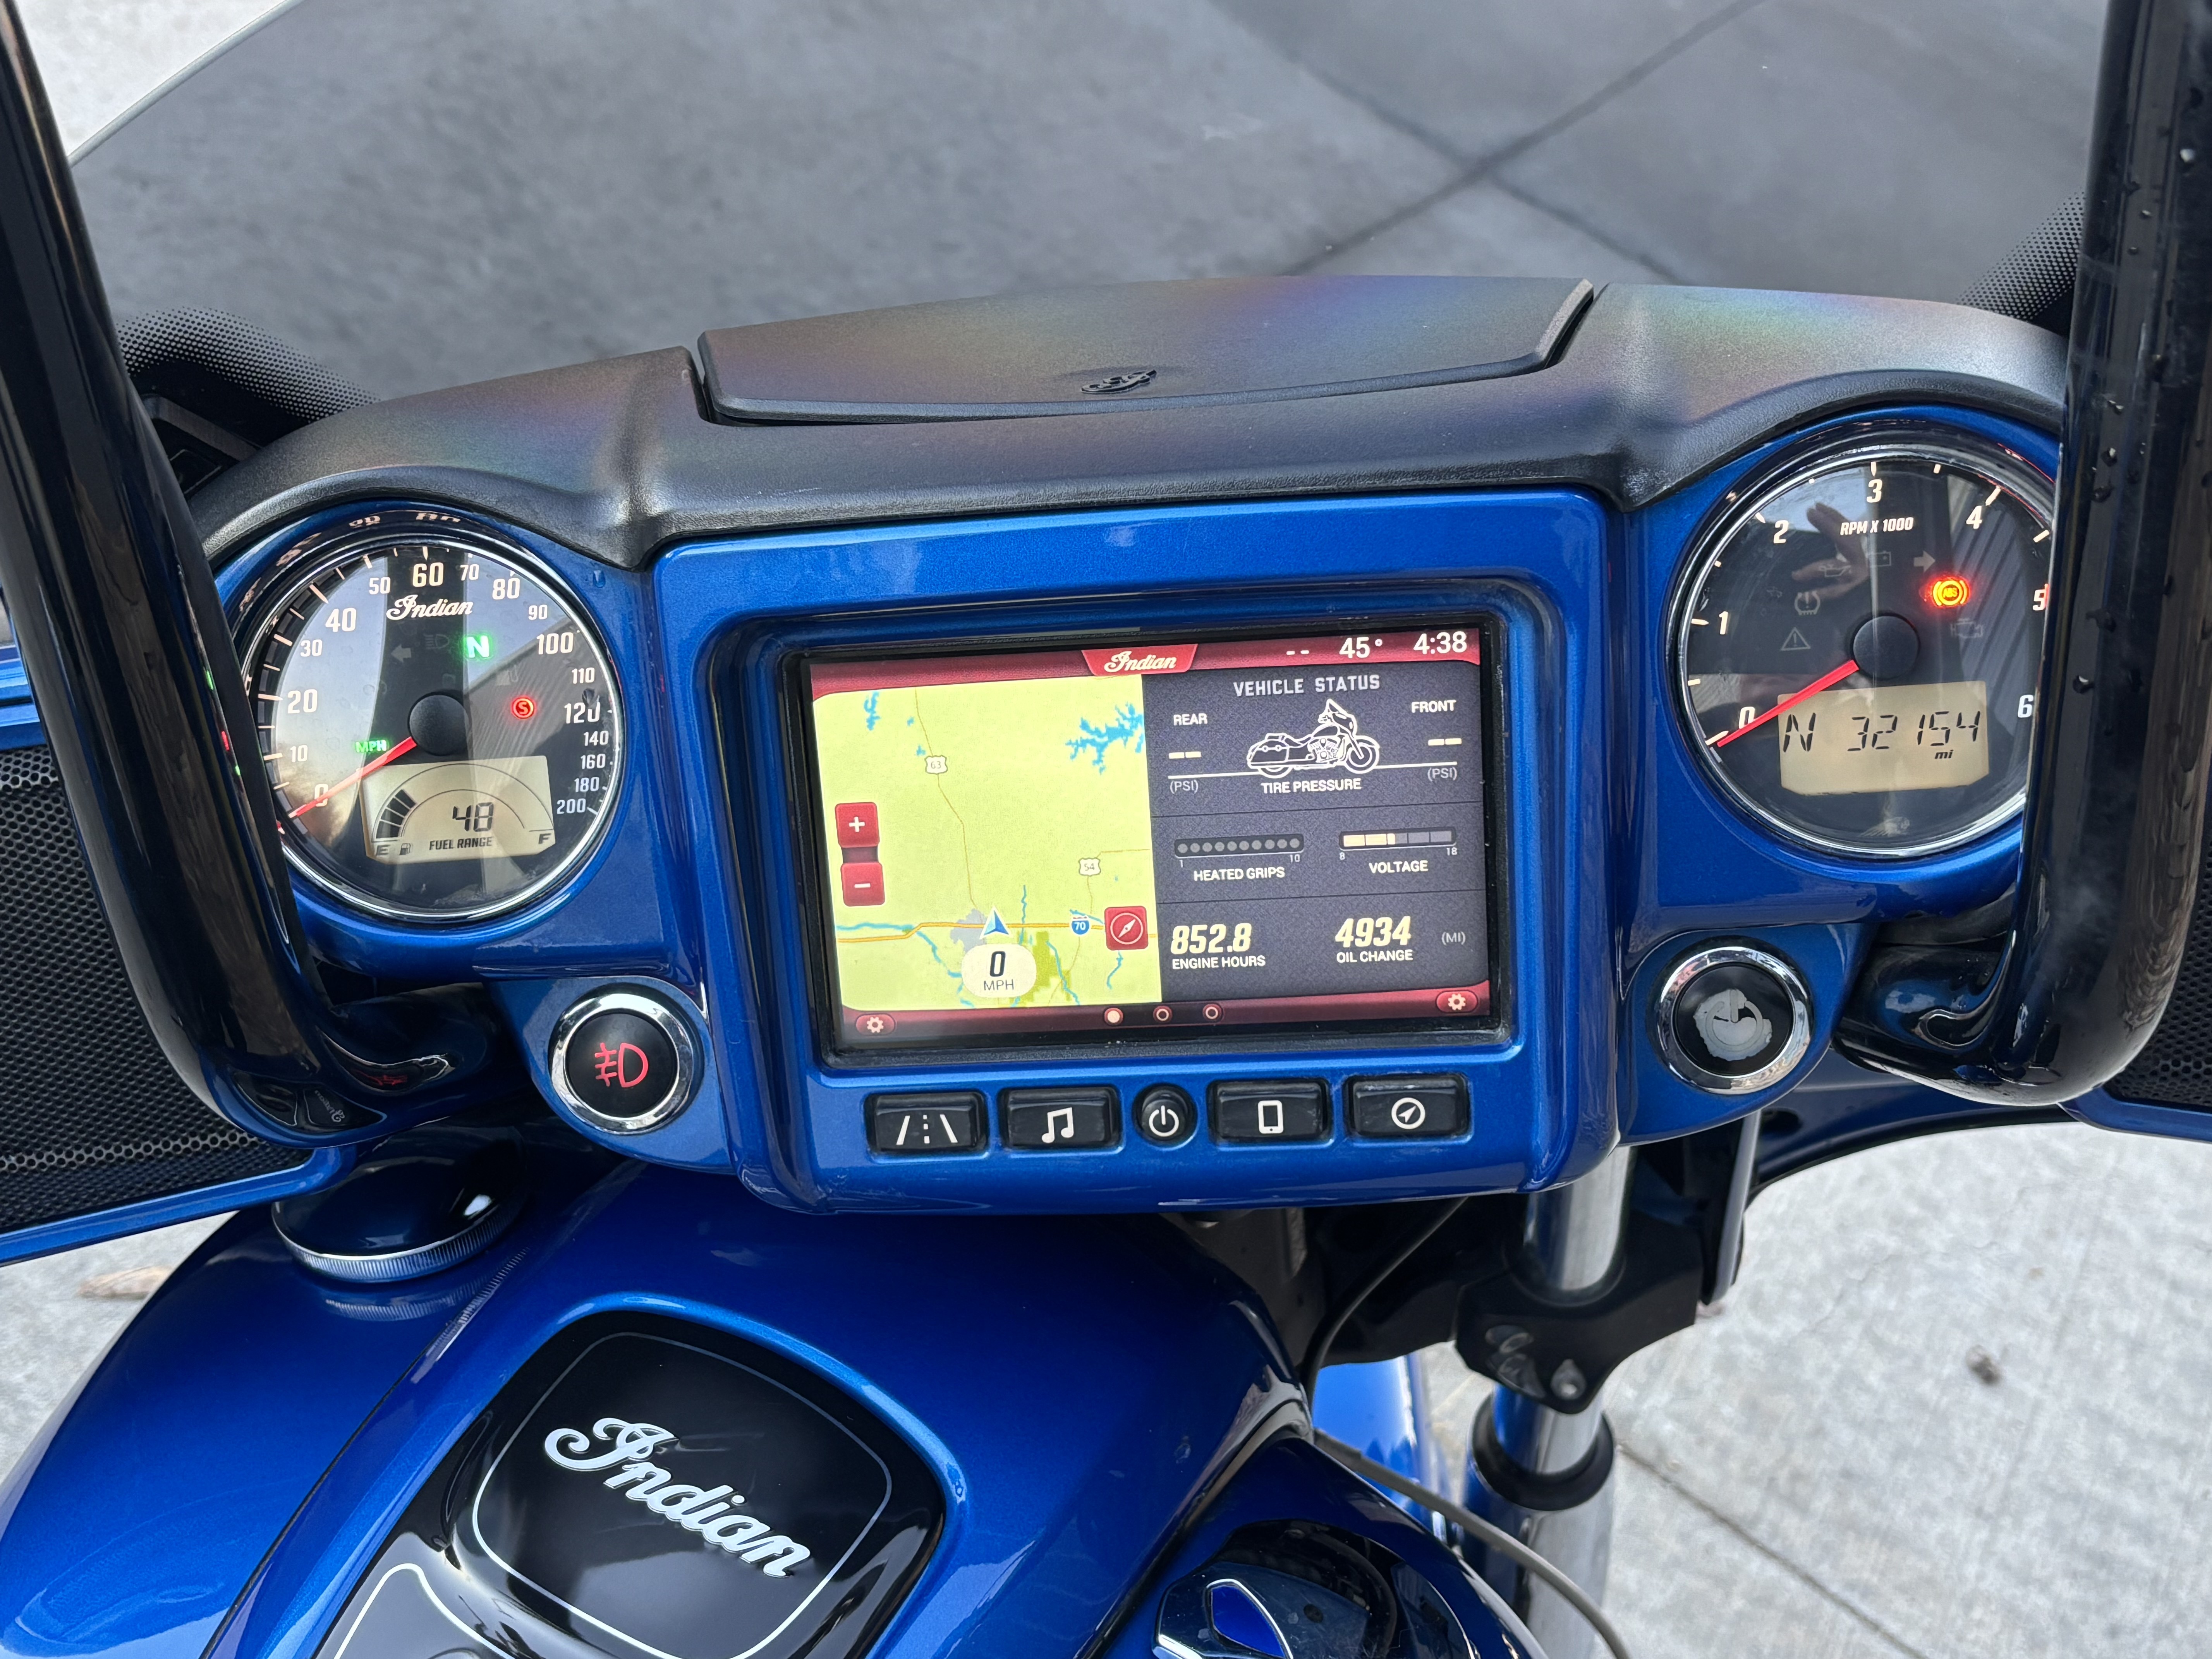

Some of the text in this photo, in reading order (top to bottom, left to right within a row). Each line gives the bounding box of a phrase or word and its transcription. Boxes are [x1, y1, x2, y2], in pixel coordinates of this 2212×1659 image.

[1867, 479, 1882, 503] 3
[1840, 517, 1914, 535] RPM X 1000
[1966, 506, 1982, 529] 4
[1774, 520, 1789, 543] 2
[413, 563, 443, 587] 60
[460, 564, 479, 580] 70
[369, 577, 391, 594] 50
[493, 577, 520, 600] 80
[386, 595, 473, 620] Indian
[2033, 589, 2047, 611] 5
[326, 608, 356, 632] 40
[528, 605, 548, 620] 90
[1718, 611, 1729, 634] 1
[301, 639, 322, 656] 30
[467, 636, 489, 657] N
[537, 633, 573, 654] 100
[1413, 632, 1467, 654] 4:38
[1104, 651, 1176, 672] Indian
[572, 668, 595, 684] 110
[1233, 675, 1380, 697] VEHICLE STATUS
[287, 690, 318, 713] 20
[1412, 700, 1456, 713] FRONT
[2018, 695, 2034, 718] 6
[565, 702, 600, 723] 120
[1173, 713, 1207, 726] REAR
[1739, 707, 1755, 729] 0
[584, 731, 609, 746] 140
[1783, 710, 1980, 752] N 32154
[290, 745, 307, 762] 10
[356, 740, 386, 752] MPH
[1935, 748, 1953, 759] mi
[581, 755, 605, 769] 160
[931, 760, 941, 770] 63
[1427, 768, 1457, 781] (PSI)
[574, 777, 599, 792] 180
[1170, 780, 1199, 793] (PSI)
[1261, 778, 1362, 793] TIRE PRESSURE
[314, 784, 328, 806] 0
[557, 799, 586, 814] 200
[452, 802, 494, 832] 48
[429, 837, 493, 850] FUEL RANGE
[539, 833, 551, 844] F
[376, 845, 390, 855] E
[1290, 854, 1300, 862] 10
[1447, 847, 1457, 855] 18
[1084, 862, 1095, 872] 54
[1194, 867, 1285, 881] HEATED GRIPS
[1369, 860, 1428, 873] VOLTAGE
[1074, 921, 1086, 931] 70
[1335, 915, 1465, 948] 4934 (MI)
[1171, 922, 1252, 955] 852.8
[990, 951, 1006, 977] 0
[1172, 955, 1265, 969] ENGINE HOURS
[1336, 949, 1413, 963] OIL CHANGE
[983, 979, 1015, 991] MPH
[544, 1417, 811, 1578] Indian
